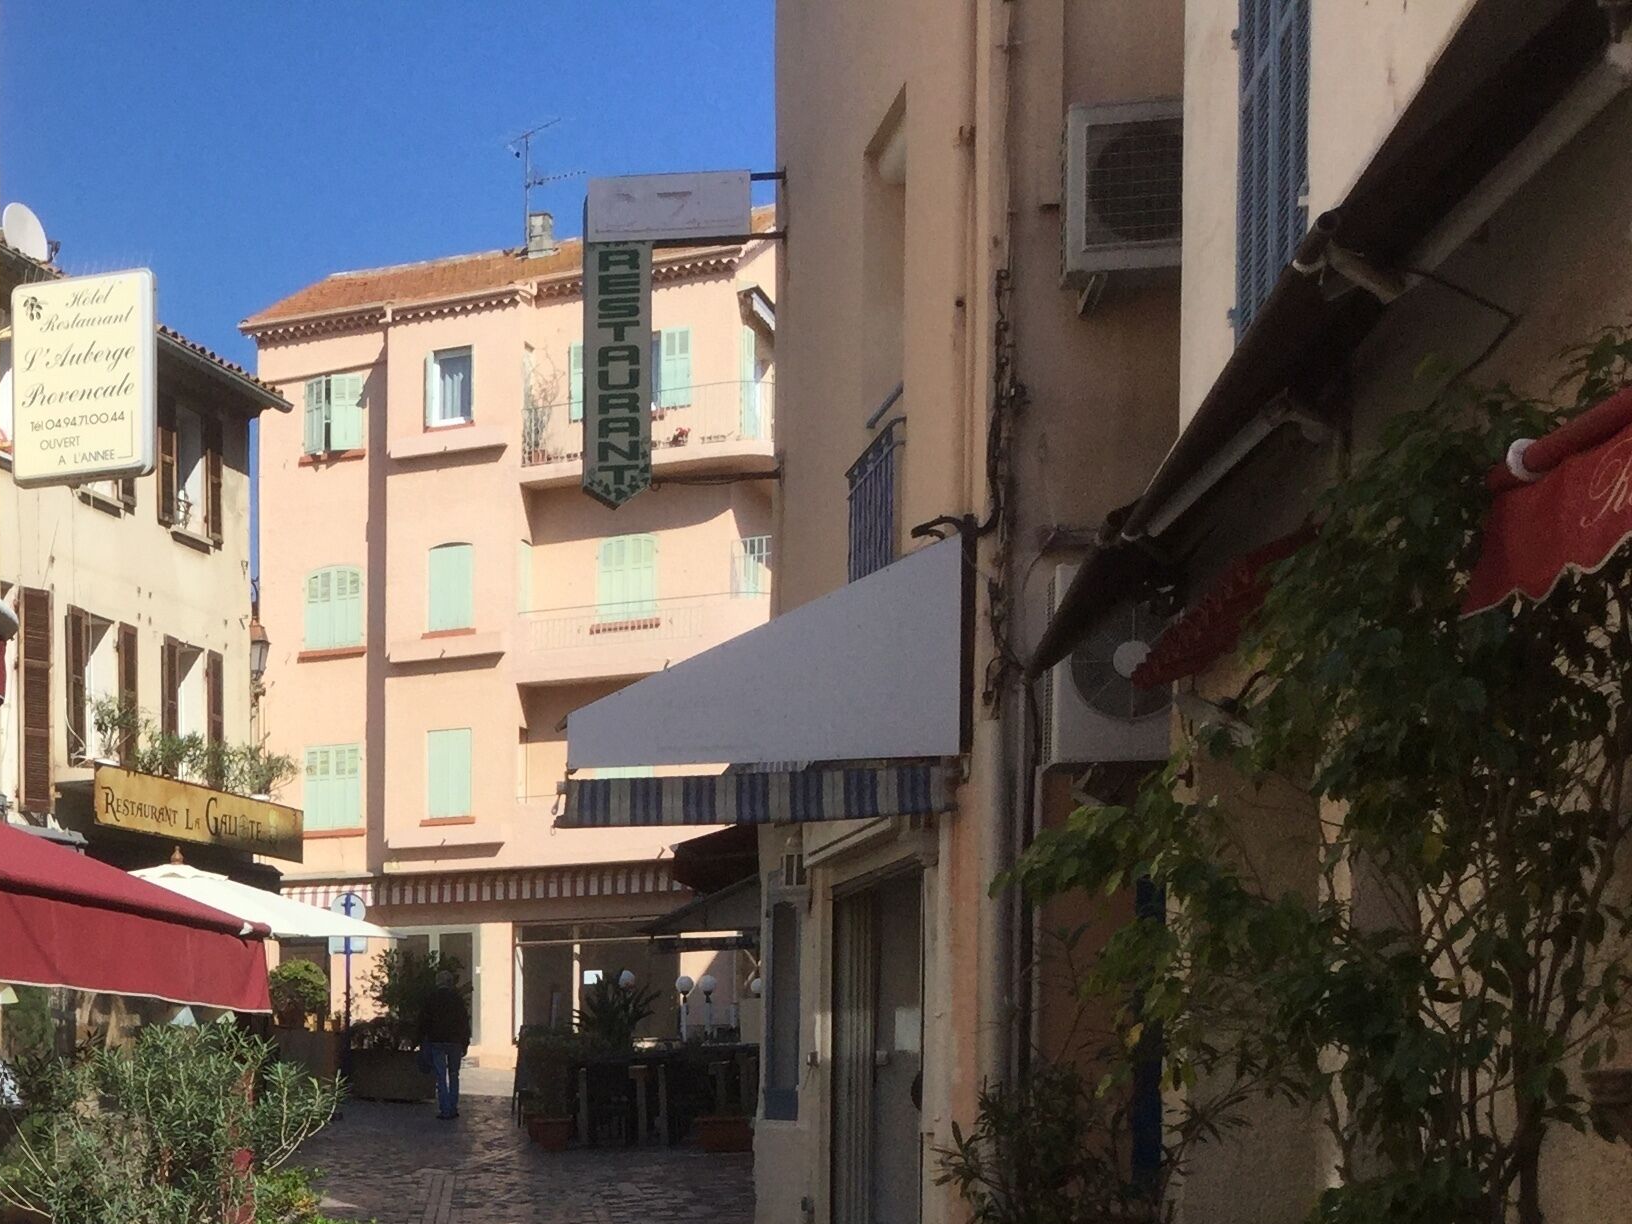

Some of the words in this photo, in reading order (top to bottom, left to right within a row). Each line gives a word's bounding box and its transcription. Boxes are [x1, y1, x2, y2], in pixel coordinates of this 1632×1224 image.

[40, 305, 135, 333] Restaurant
[23, 340, 136, 373] L'Auberge
[597, 249, 641, 486] RESTAURANT
[40, 436, 80, 451] OUVERT
[58, 455, 67, 466] A
